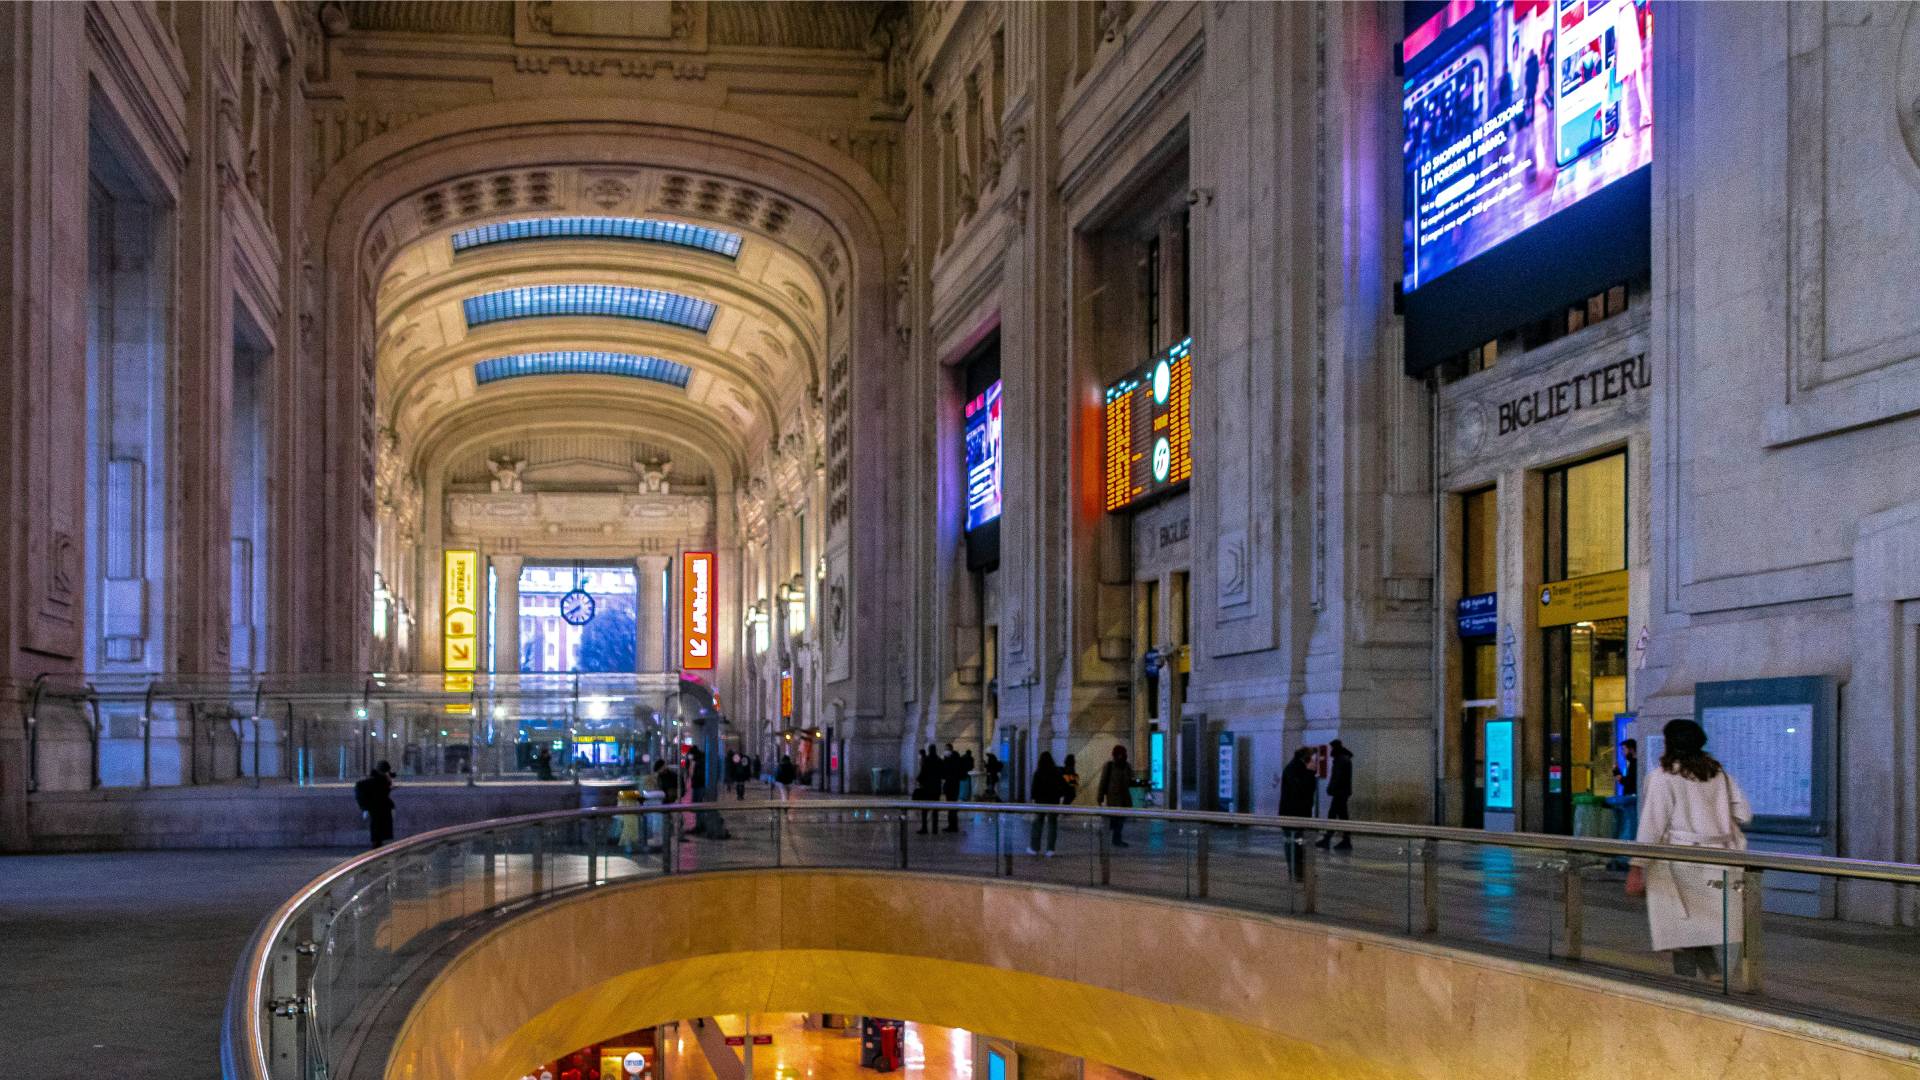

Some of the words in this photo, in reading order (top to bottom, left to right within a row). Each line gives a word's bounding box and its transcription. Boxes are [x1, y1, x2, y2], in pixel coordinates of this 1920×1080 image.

[1421, 162, 1431, 177] LO
[1433, 134, 1472, 169] SHOPPING
[1473, 127, 1483, 143] IN
[1484, 99, 1524, 136] STAZIONE
[1427, 177, 1433, 191] A
[1434, 156, 1467, 186] PORTATA
[1467, 149, 1476, 165] DI
[456, 560, 466, 605] CENTRALE
